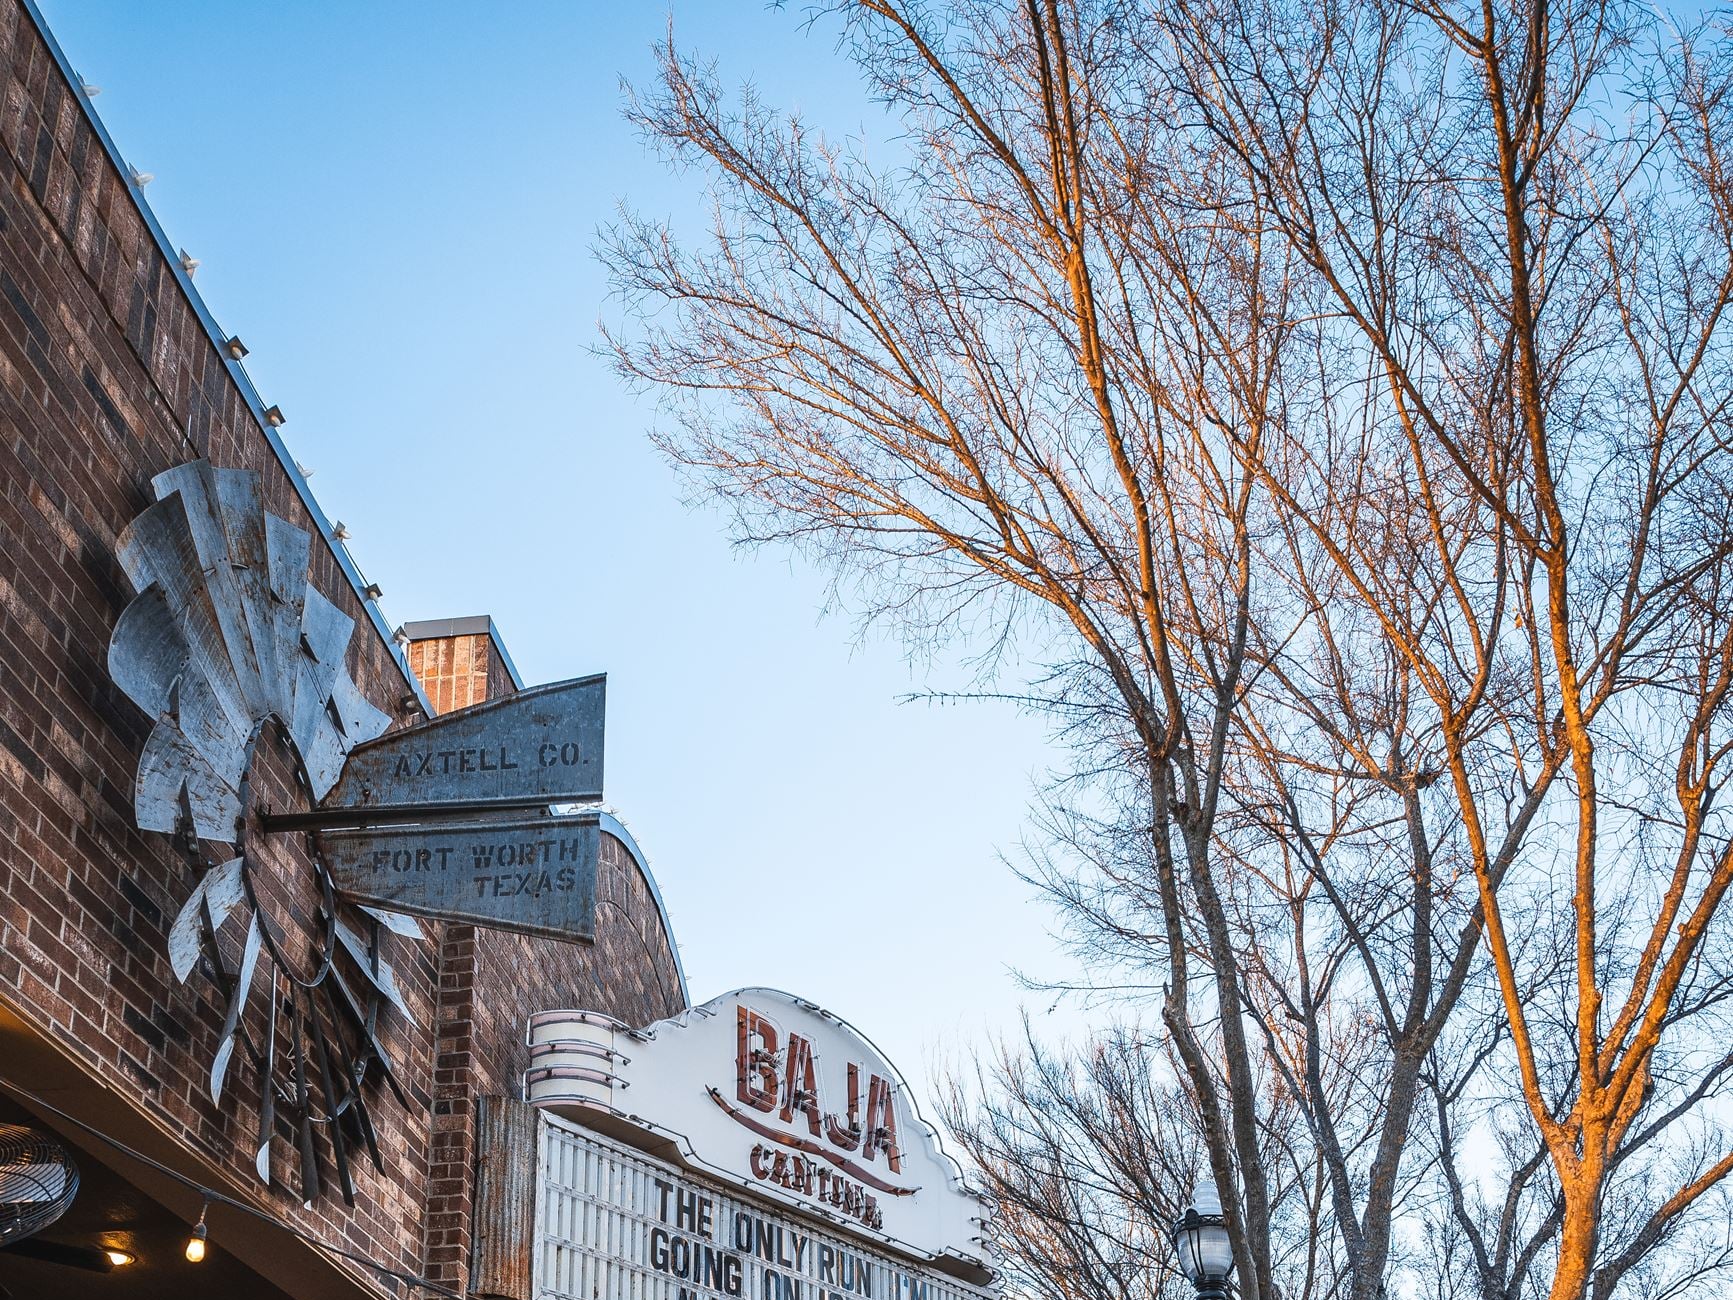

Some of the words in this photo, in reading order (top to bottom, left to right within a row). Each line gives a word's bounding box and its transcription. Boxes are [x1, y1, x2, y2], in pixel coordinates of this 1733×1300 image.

[394, 747, 518, 777] AXTELL
[538, 742, 589, 768] CO.
[372, 847, 454, 874] FORT
[472, 838, 579, 869] WORTH
[474, 868, 576, 898] TEXAS
[736, 1004, 905, 1175] BAJA
[651, 1227, 742, 1297] GOING
[654, 1179, 713, 1240] THE
[735, 1212, 808, 1272] ONLY
[819, 1243, 872, 1298] RUN
